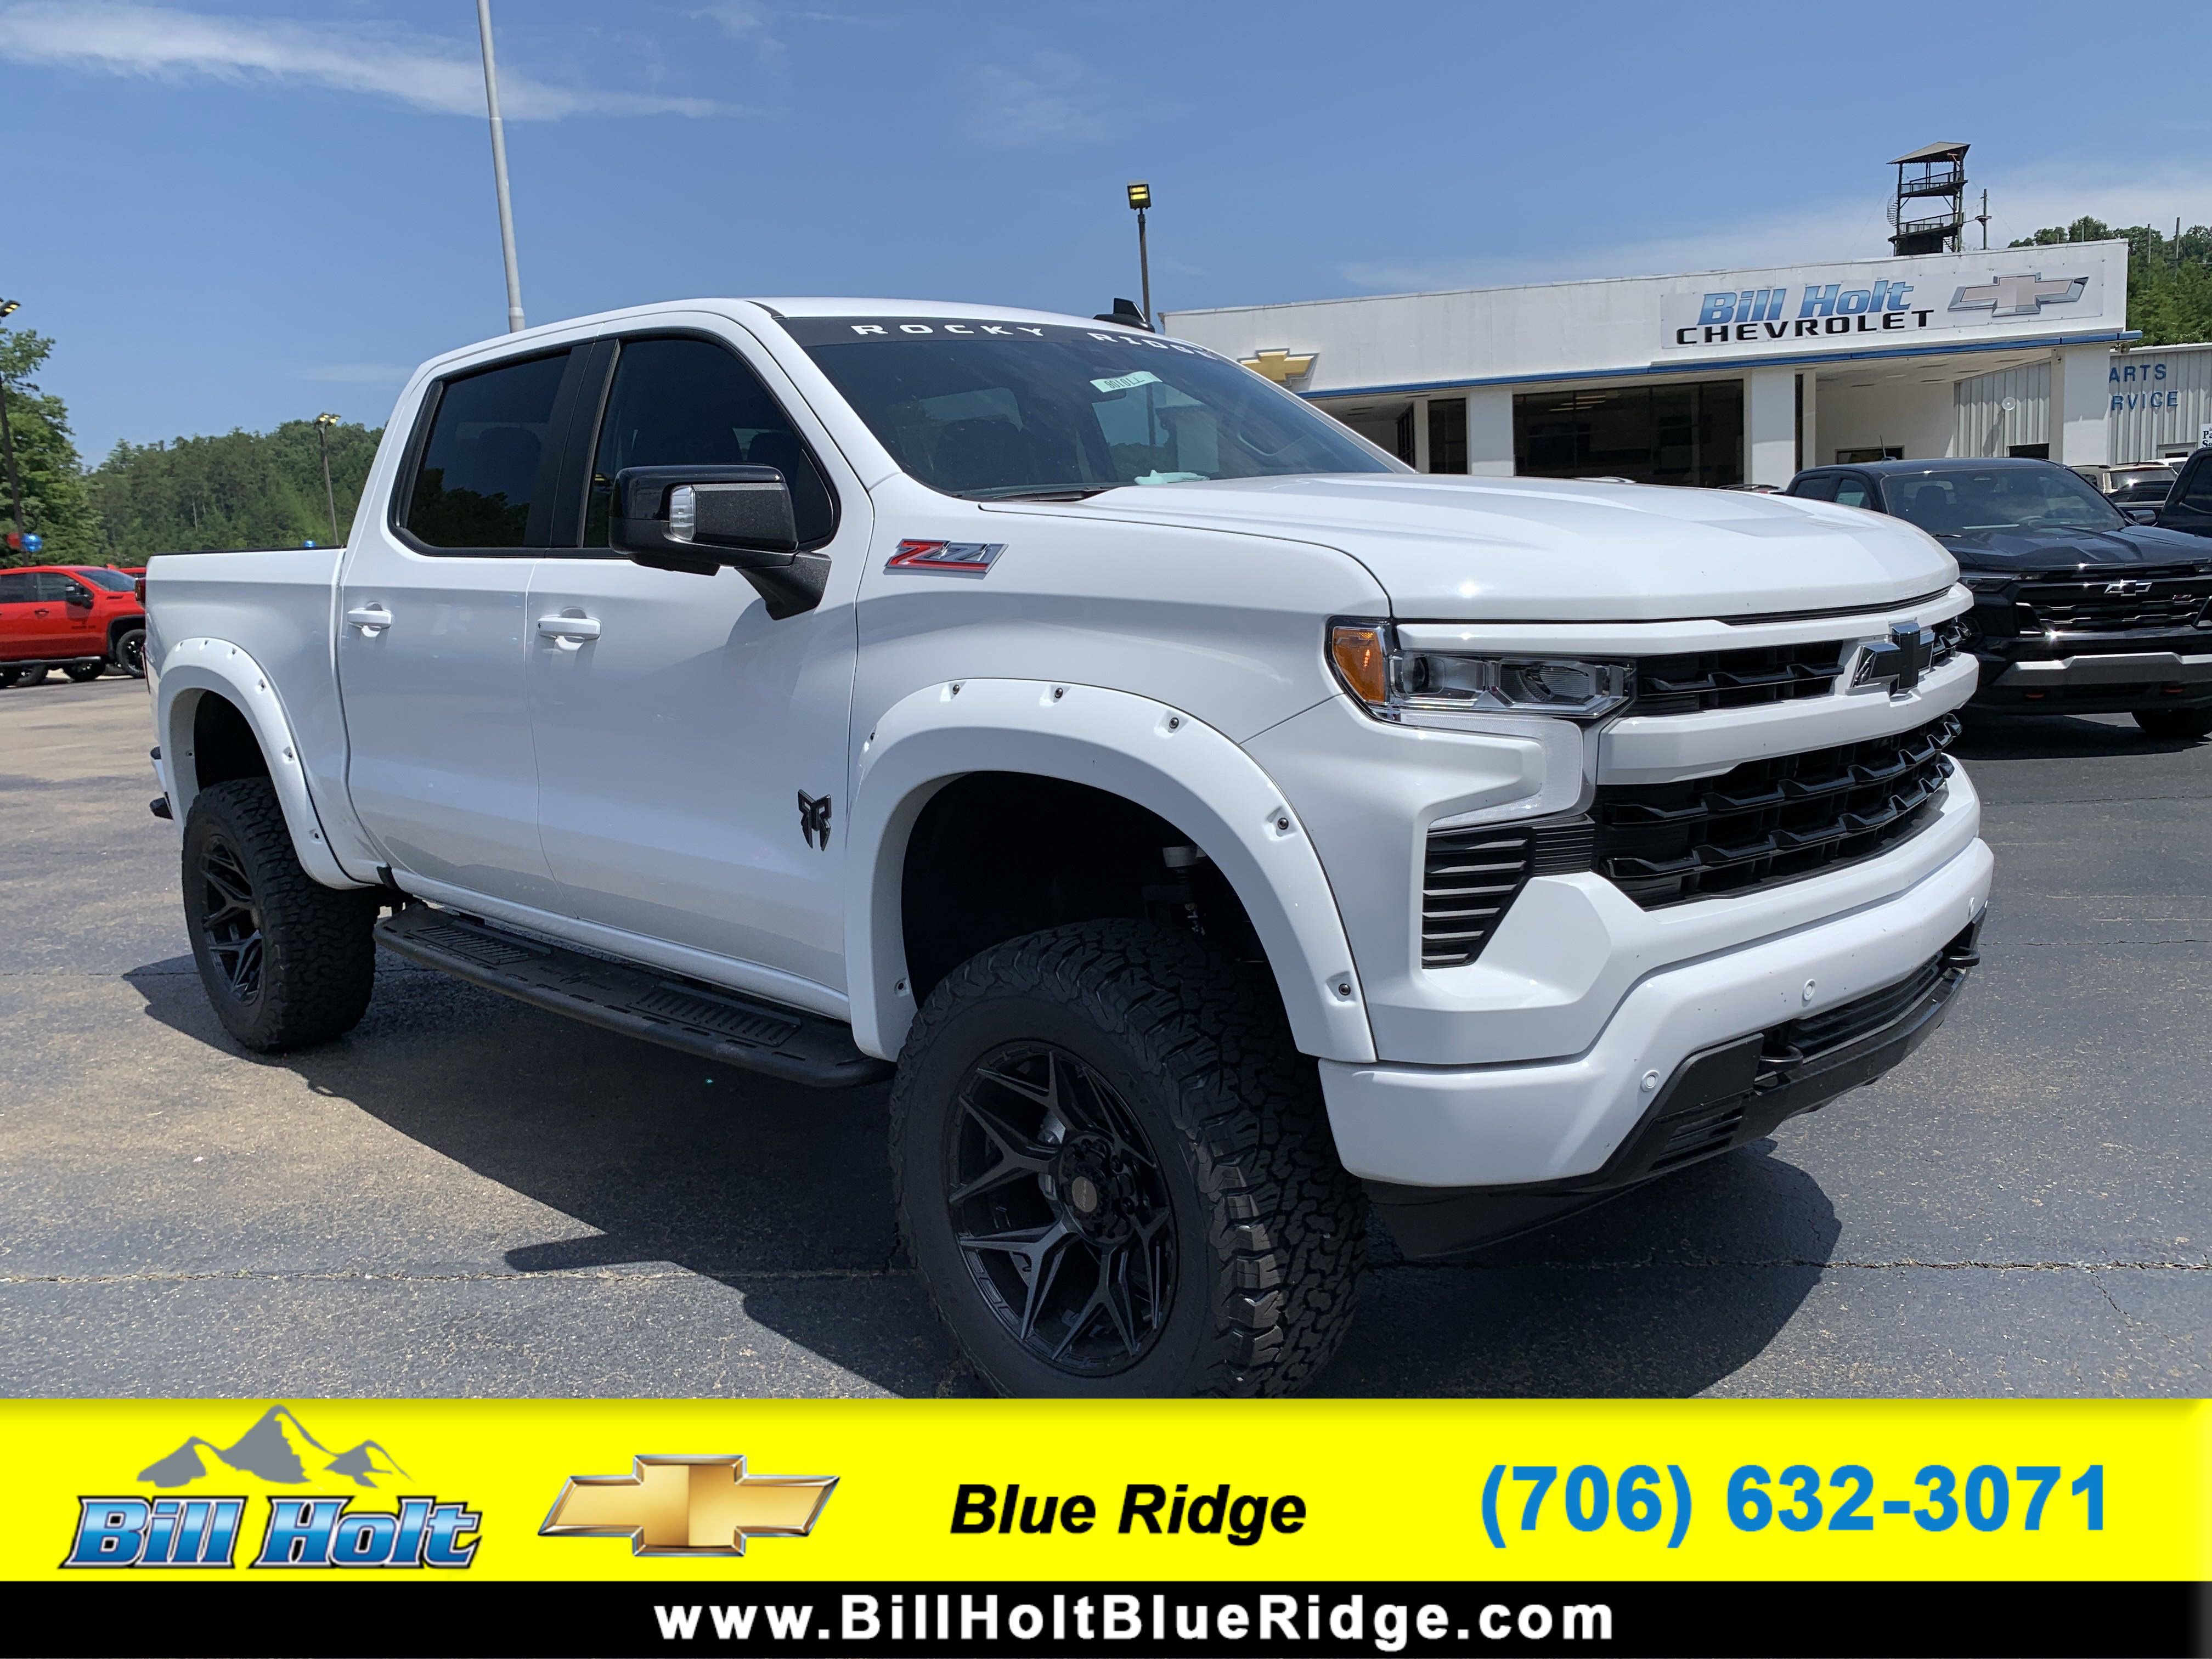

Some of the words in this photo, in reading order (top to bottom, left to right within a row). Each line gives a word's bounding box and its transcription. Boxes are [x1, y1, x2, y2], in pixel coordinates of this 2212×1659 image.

[1698, 288, 1787, 326] Bill
[1798, 280, 1914, 318] Holt
[850, 324, 1044, 337] ROCKY
[1676, 309, 1934, 345] CHEVROLET
[884, 538, 1009, 573] Z71
